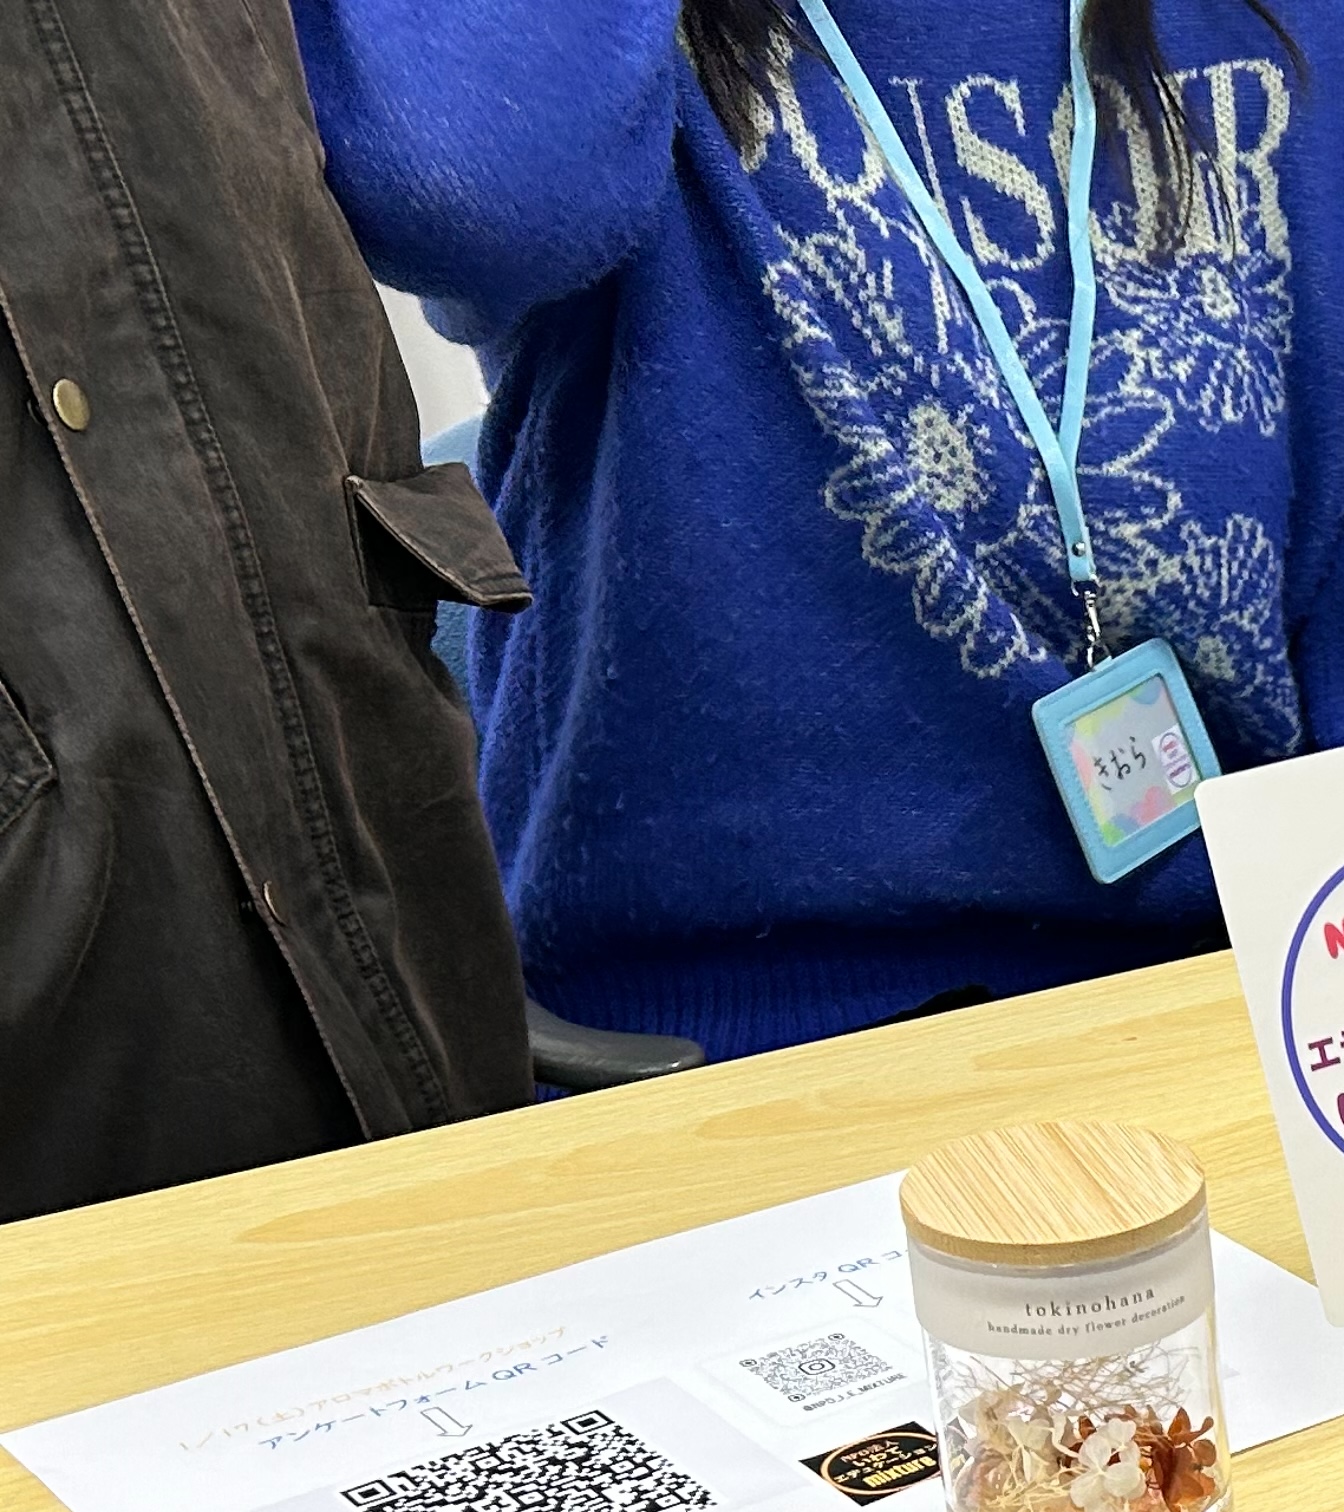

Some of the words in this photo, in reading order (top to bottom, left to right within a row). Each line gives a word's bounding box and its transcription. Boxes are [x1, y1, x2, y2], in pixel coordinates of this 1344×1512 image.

[1092, 736, 1148, 790] きおら
[986, 1321, 1053, 1336] handmade
[1057, 1325, 1080, 1336] dry
[1085, 1319, 1127, 1334] flower
[1131, 1295, 1186, 1324] decoration
[1025, 1288, 1156, 1317] tokinohana
[852, 1446, 904, 1468] いわて
[861, 1456, 938, 1488] mixture
